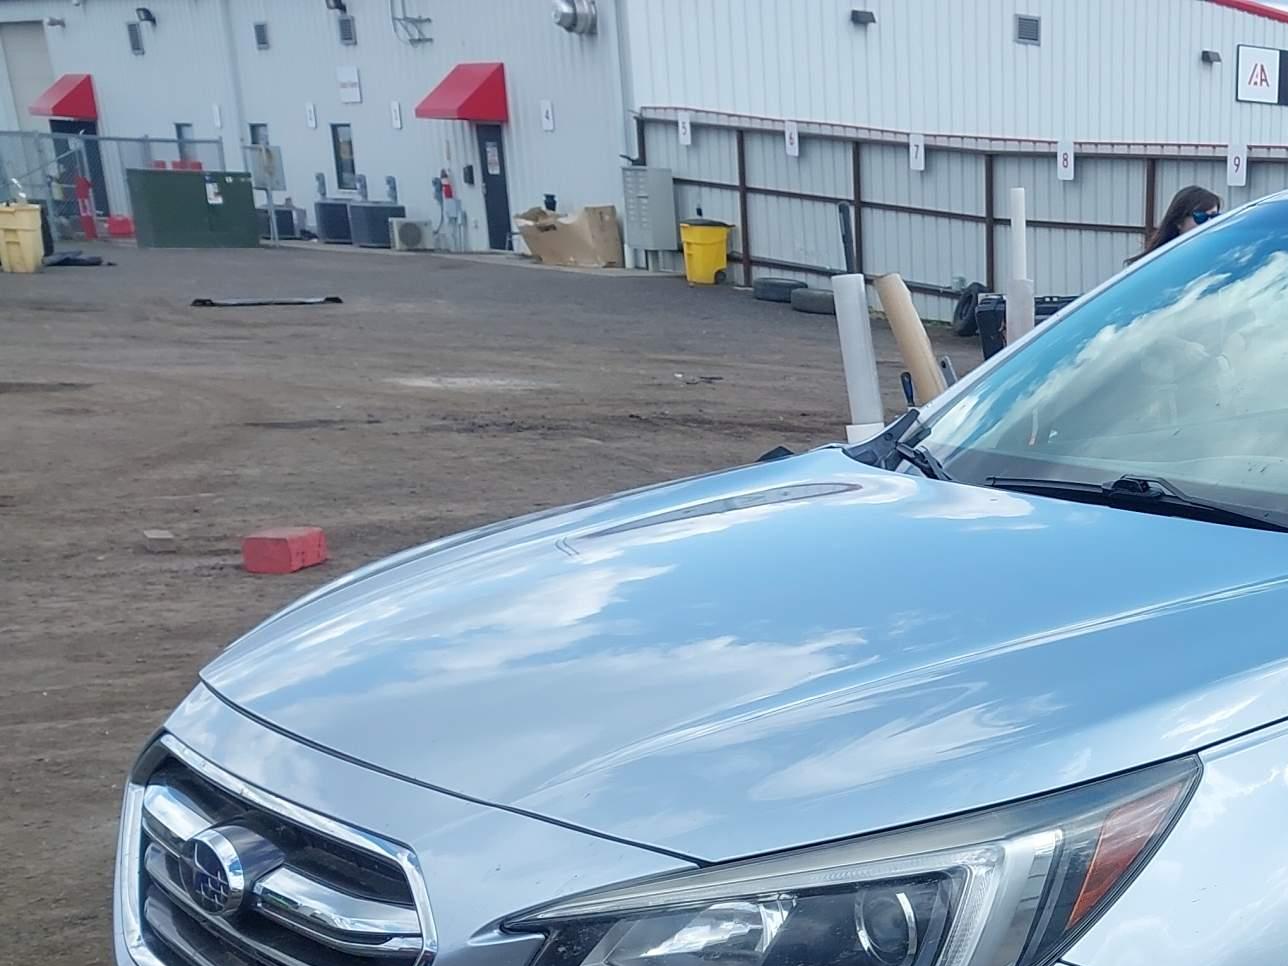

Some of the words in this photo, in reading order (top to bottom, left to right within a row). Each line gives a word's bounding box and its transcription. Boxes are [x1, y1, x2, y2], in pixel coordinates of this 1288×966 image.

[681, 121, 688, 136] 5
[788, 132, 795, 147] 6
[913, 143, 920, 161] 7
[1062, 151, 1069, 169] 8
[1233, 155, 1241, 174] 9
